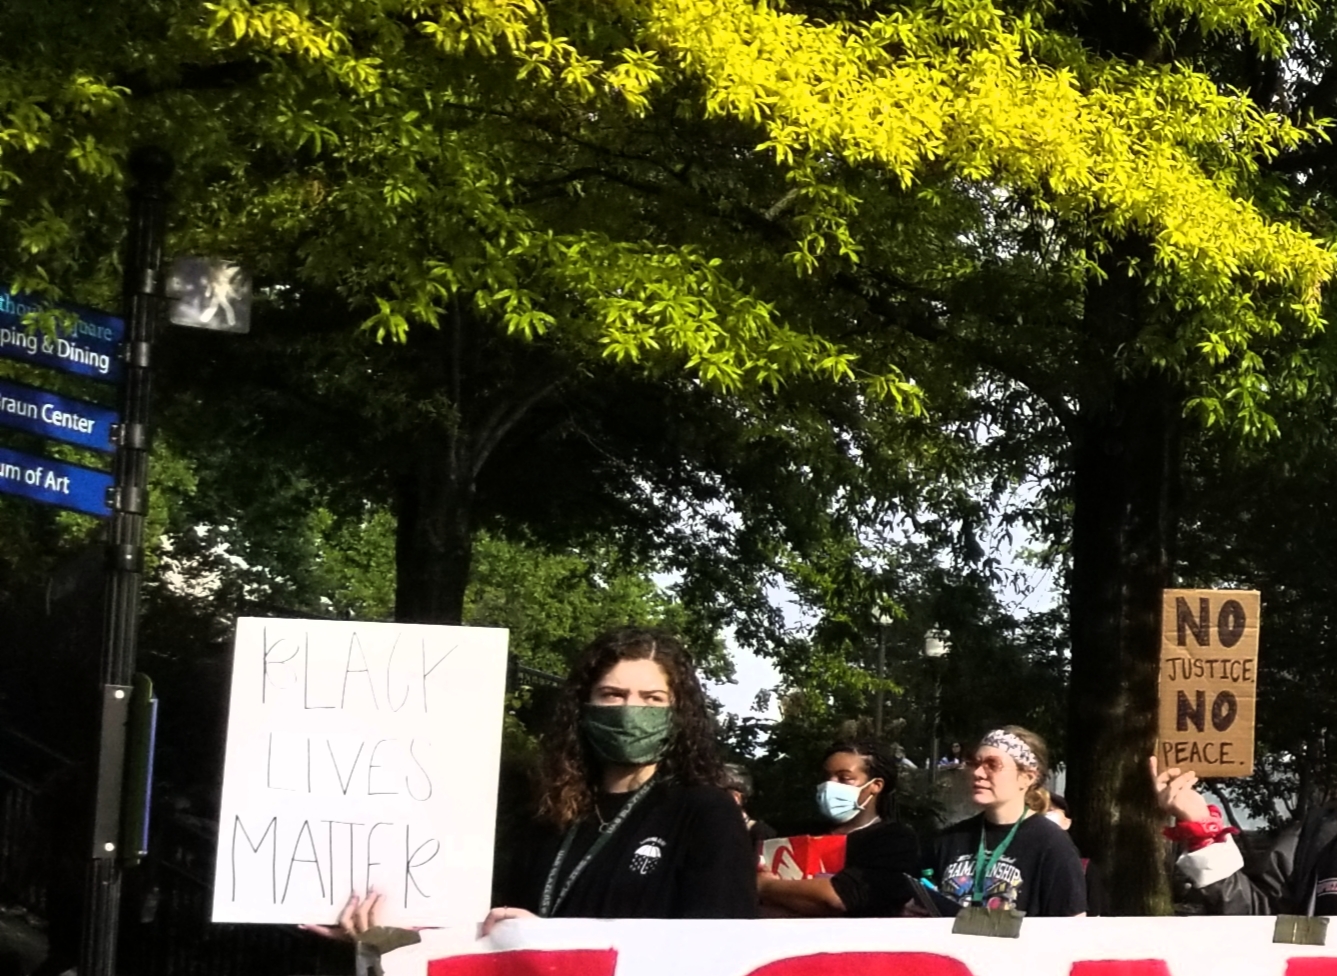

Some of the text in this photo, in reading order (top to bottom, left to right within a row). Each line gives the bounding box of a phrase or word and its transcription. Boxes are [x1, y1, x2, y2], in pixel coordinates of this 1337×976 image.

[41, 334, 54, 354] &
[57, 338, 110, 374] Dining
[0, 394, 96, 434] raun Center
[25, 467, 43, 486] of
[44, 471, 70, 494] Art
[1175, 596, 1246, 648] NO
[262, 626, 459, 713] BLACK
[1176, 690, 1238, 732] NO
[266, 732, 433, 801] LIVES
[1162, 741, 1246, 767] PEACE.
[231, 814, 441, 909] MATTER
